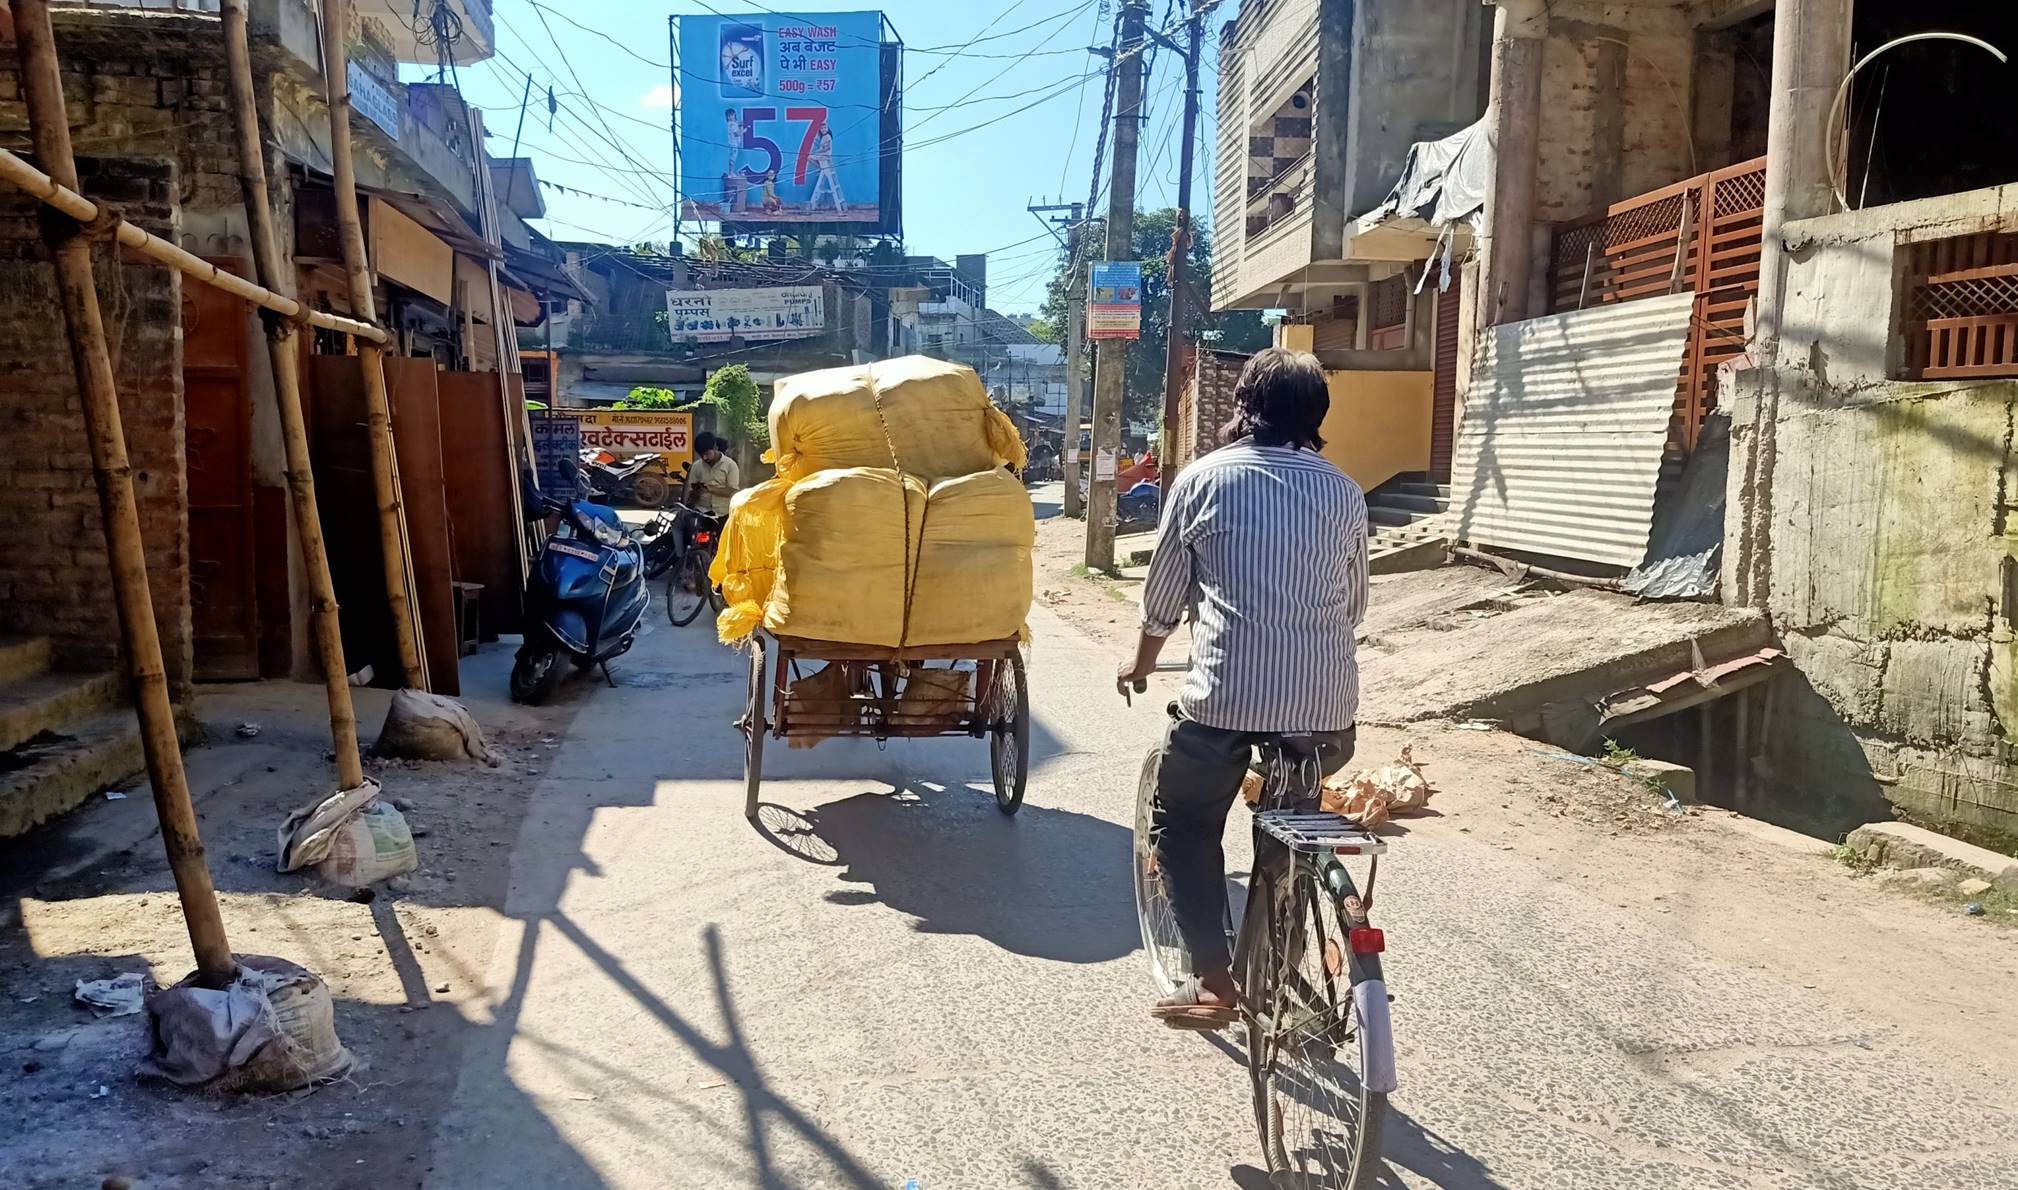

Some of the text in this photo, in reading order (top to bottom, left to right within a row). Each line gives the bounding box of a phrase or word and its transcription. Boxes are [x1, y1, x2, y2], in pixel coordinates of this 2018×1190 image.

[778, 27, 837, 38] EASY WASH
[780, 41, 836, 52] अब बजट
[732, 56, 754, 69] Surf
[780, 55, 837, 70] पे भी EASY
[779, 79, 806, 93] 500g
[817, 79, 836, 91] ₹57
[740, 107, 828, 185] 57
